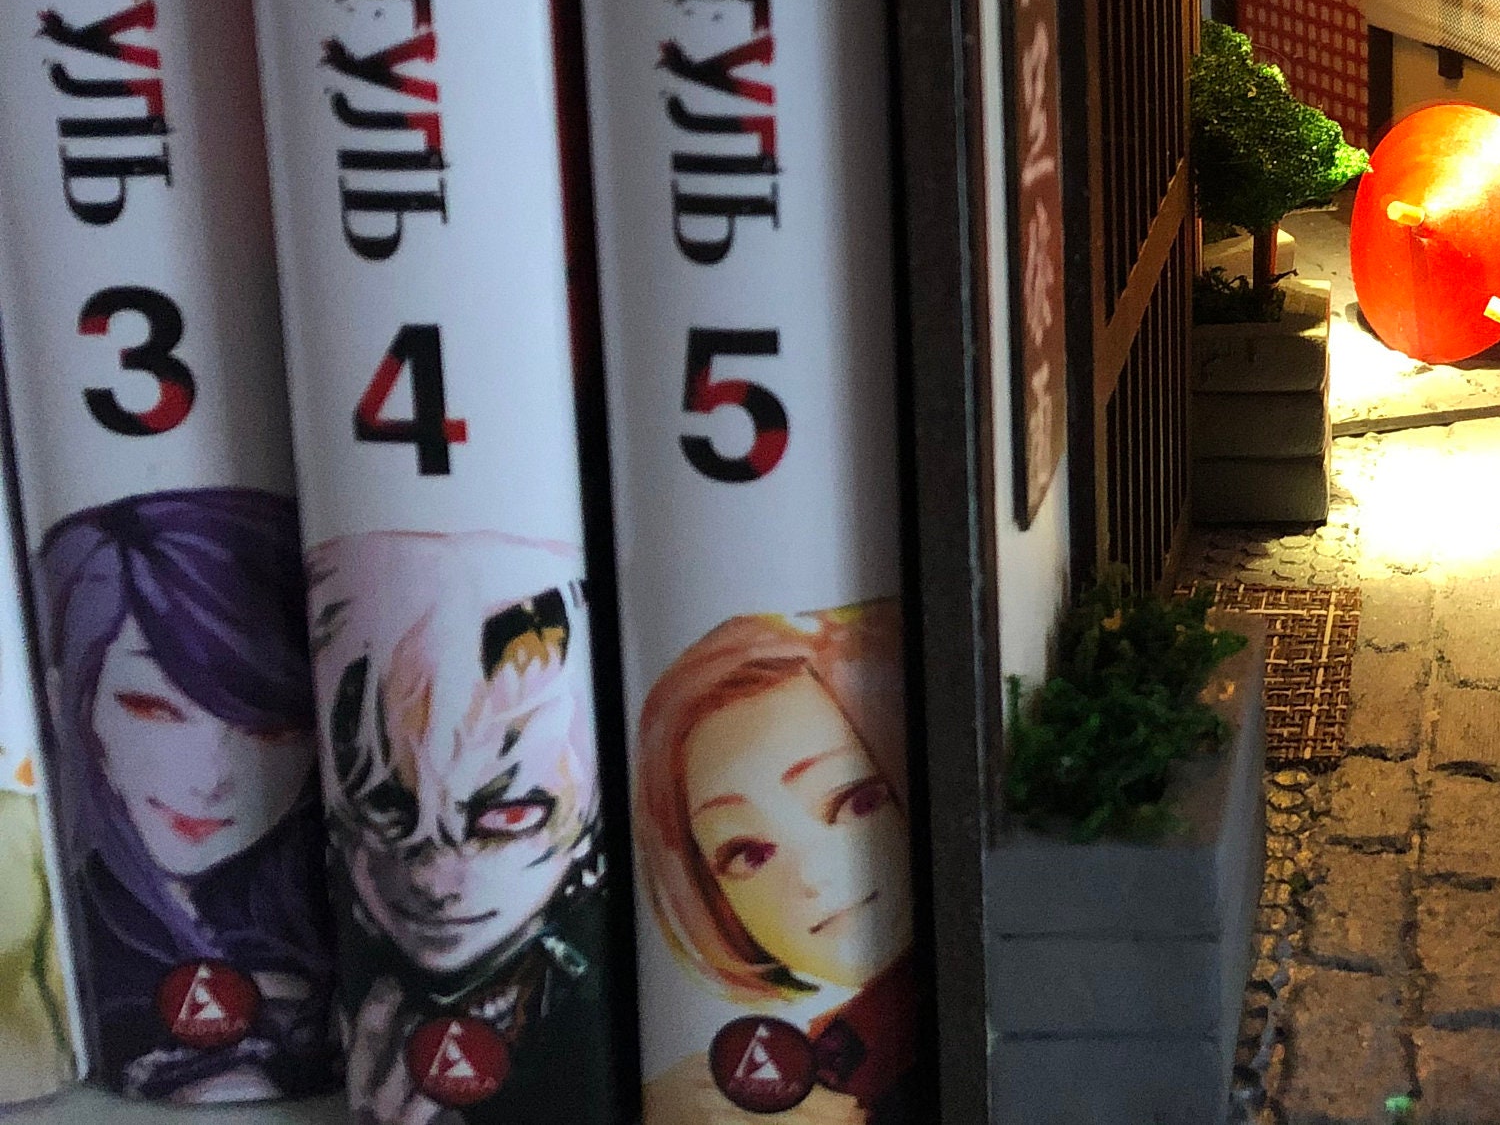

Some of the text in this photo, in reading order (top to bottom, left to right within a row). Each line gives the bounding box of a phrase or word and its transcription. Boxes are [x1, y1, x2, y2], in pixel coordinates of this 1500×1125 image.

[77, 285, 196, 437] 3
[353, 322, 468, 476] 4
[678, 326, 790, 484] 5
